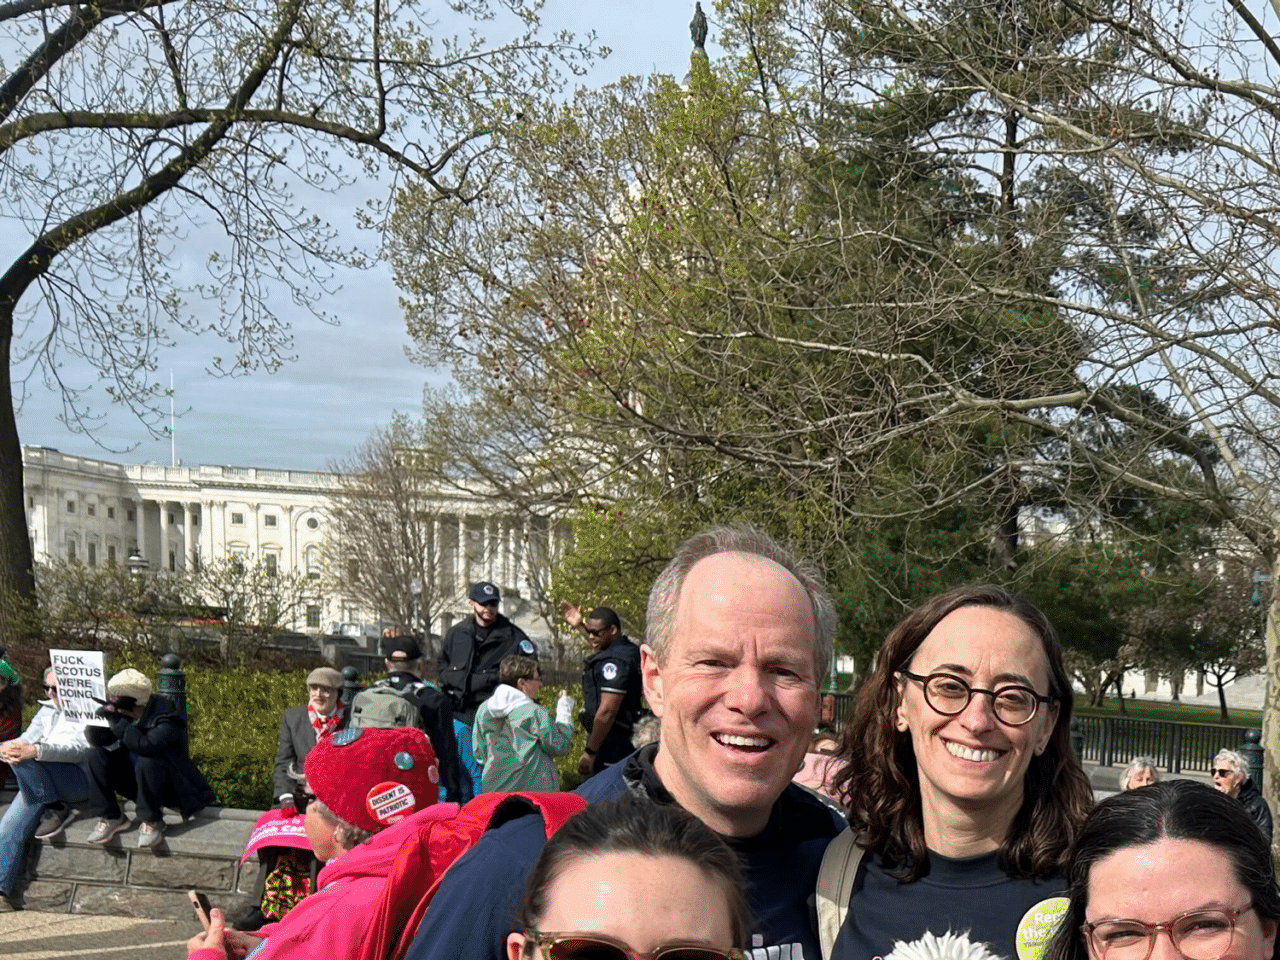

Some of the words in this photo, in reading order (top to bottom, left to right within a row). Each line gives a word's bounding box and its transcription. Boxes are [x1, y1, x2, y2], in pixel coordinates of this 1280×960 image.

[53, 655, 84, 665] FUCK
[55, 666, 101, 677] SCOTUS
[57, 677, 92, 688] WE'RE
[59, 689, 93, 699] DOING
[61, 699, 70, 708] IT
[372, 790, 397, 806] DISSENT
[397, 786, 405, 795] IS
[379, 798, 409, 817] PATRIOTIC
